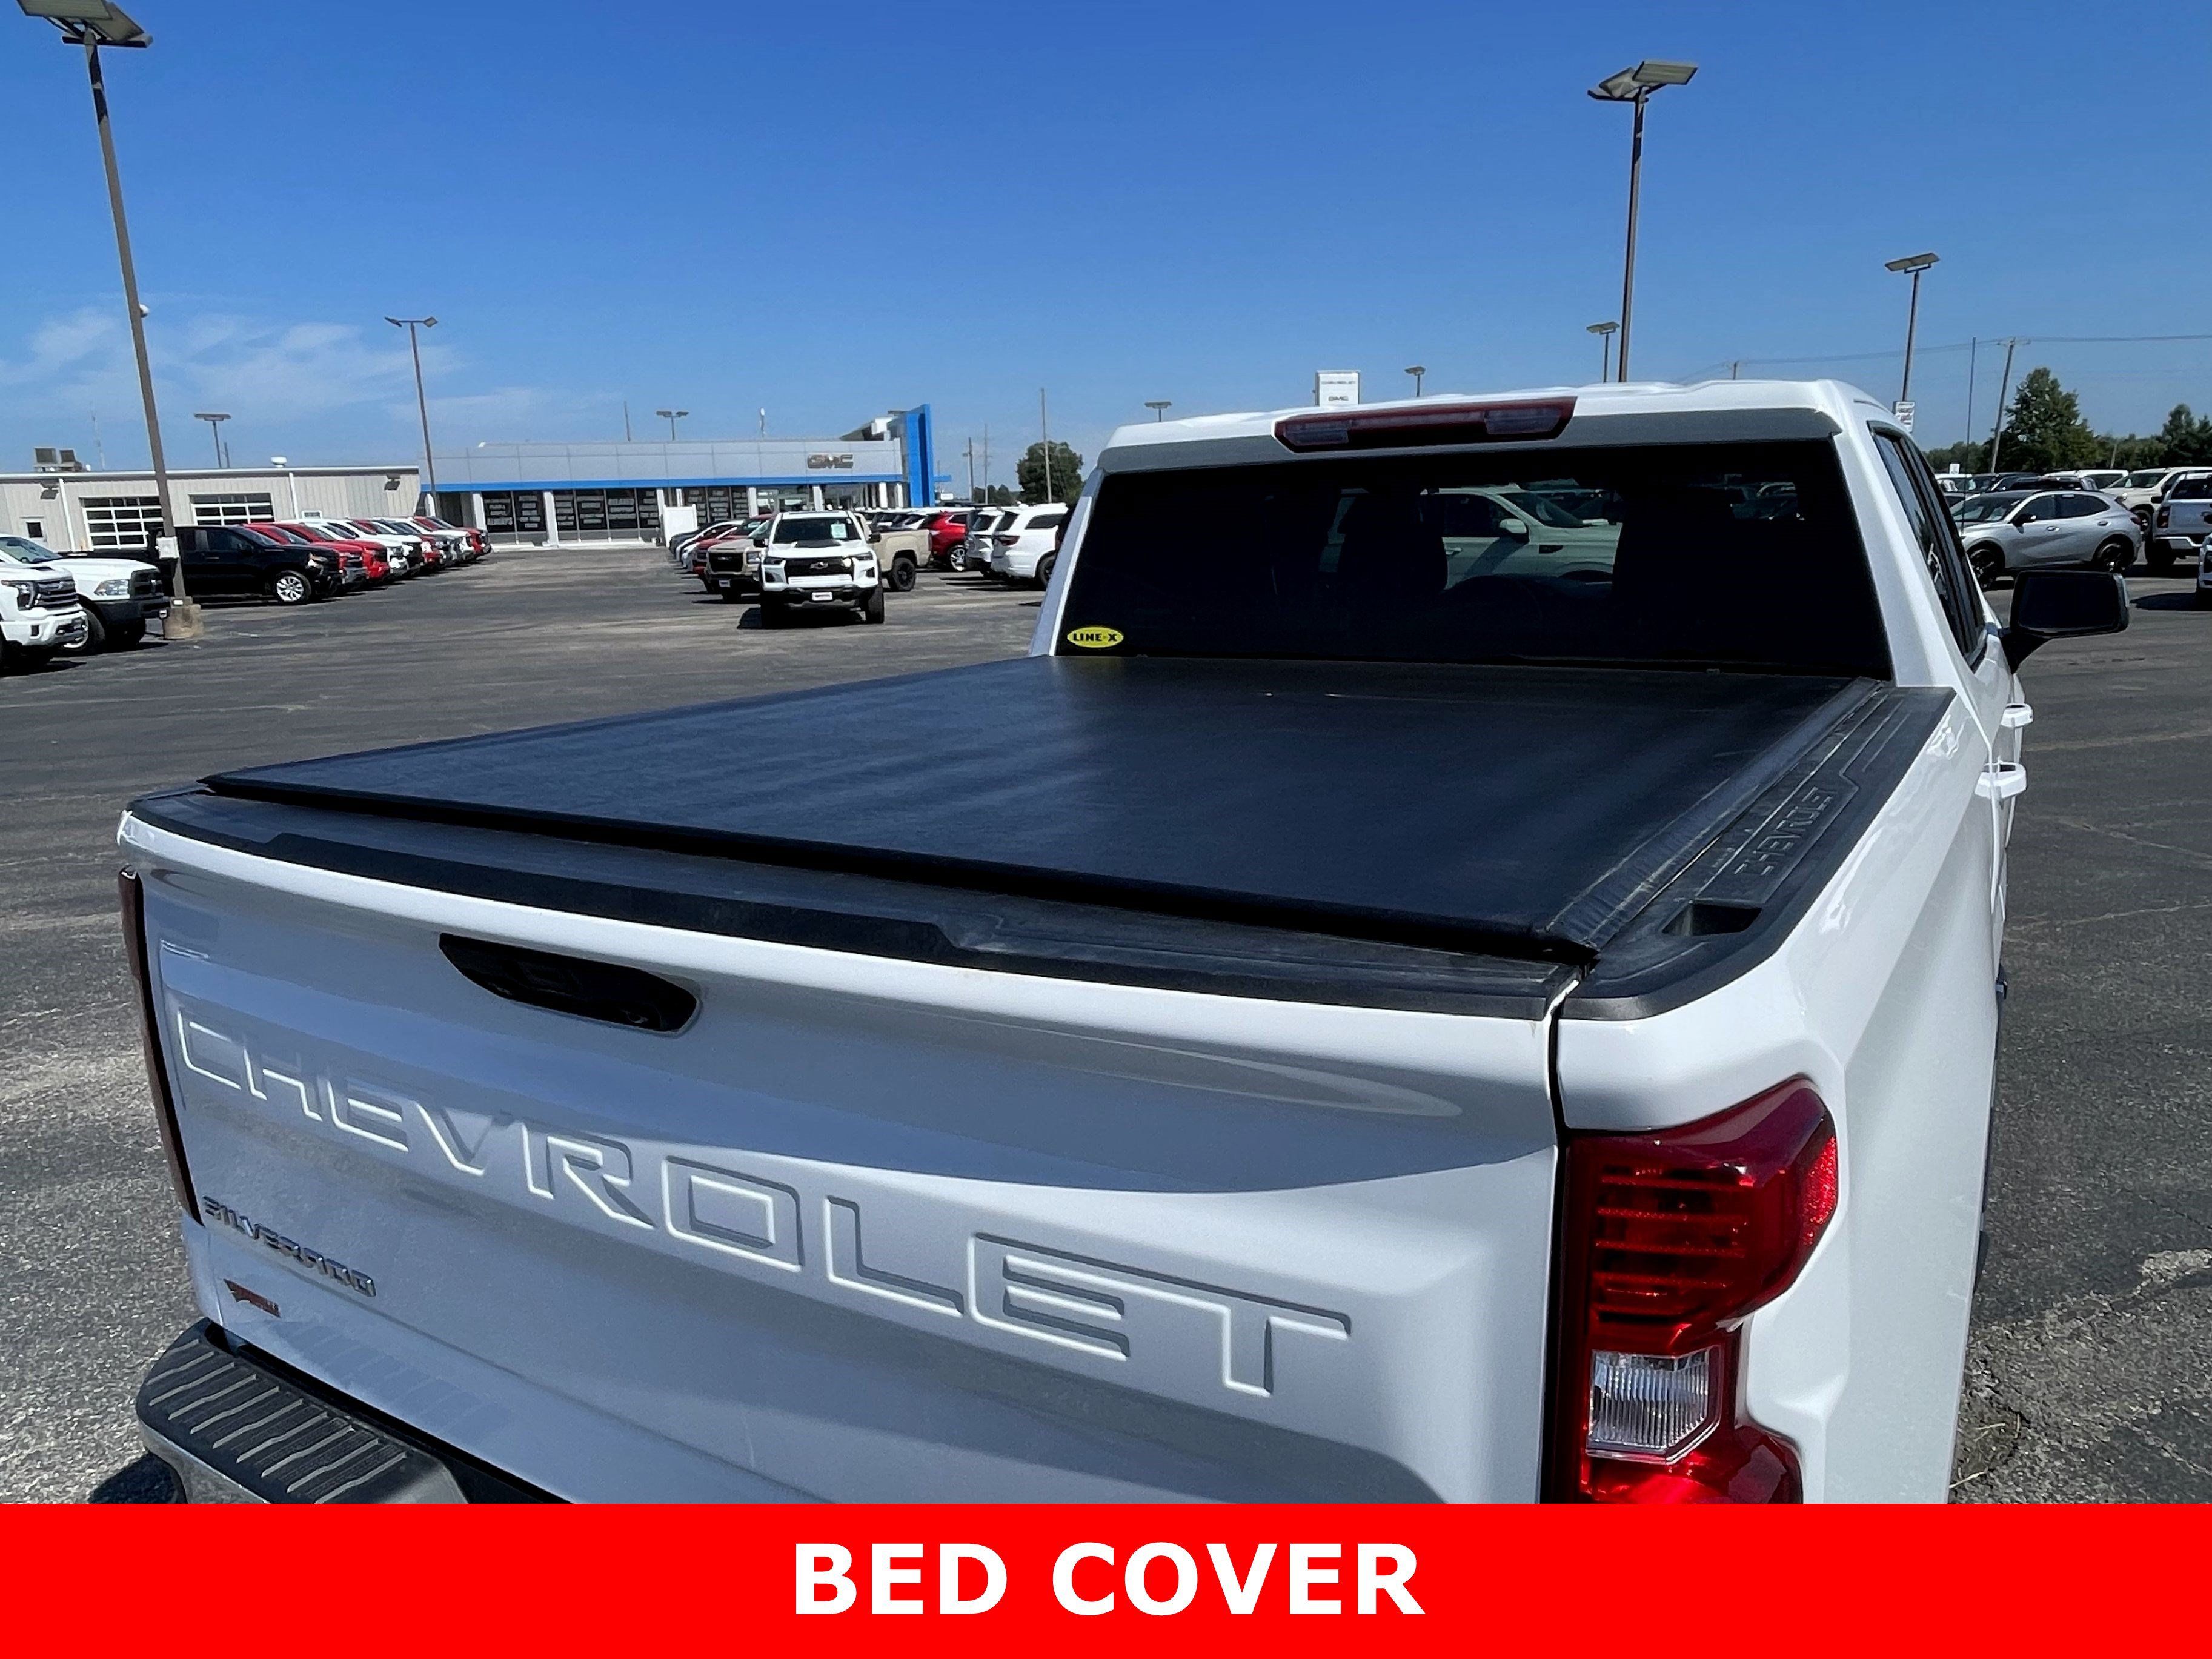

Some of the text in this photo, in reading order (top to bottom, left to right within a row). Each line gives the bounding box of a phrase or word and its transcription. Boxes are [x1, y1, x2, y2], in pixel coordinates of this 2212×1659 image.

[808, 454, 854, 469] GMC
[1072, 633, 1118, 642] LINE-X
[1733, 786, 1839, 876] CHEVROLET
[177, 1007, 1352, 1397] CHEVROLET
[202, 1195, 377, 1298] SILVERADO
